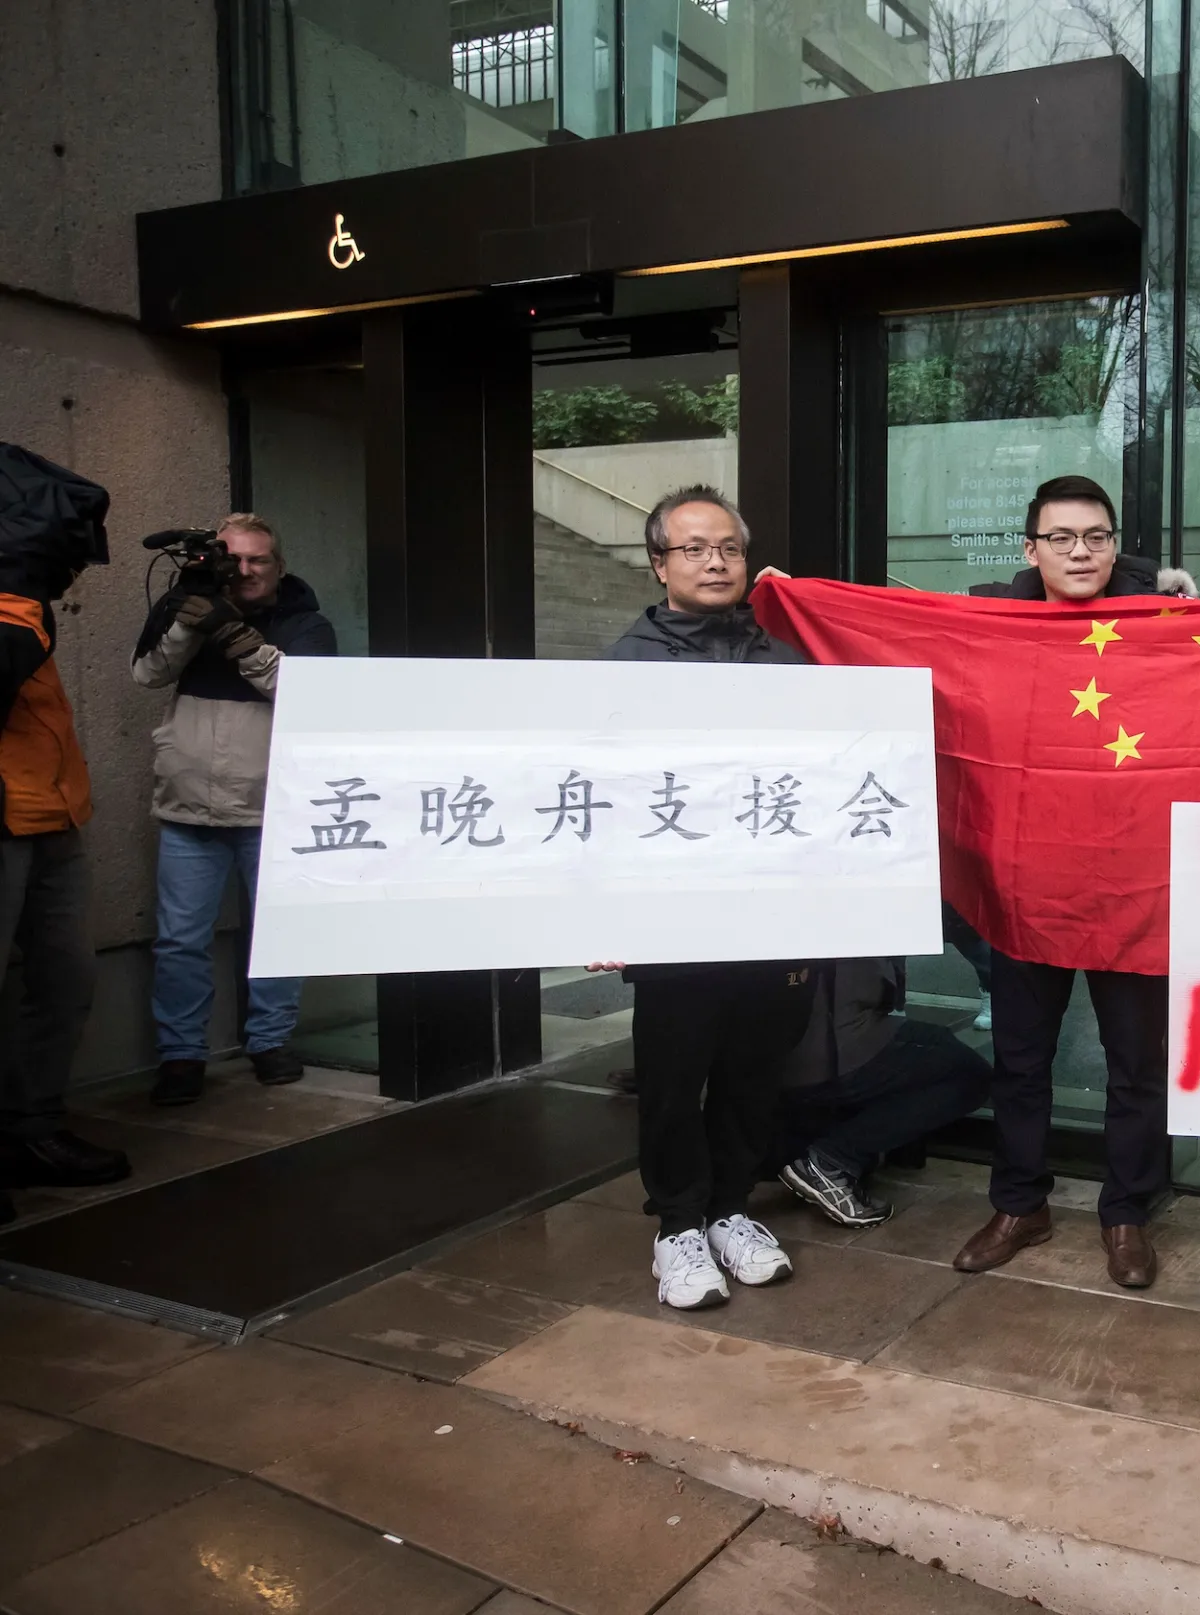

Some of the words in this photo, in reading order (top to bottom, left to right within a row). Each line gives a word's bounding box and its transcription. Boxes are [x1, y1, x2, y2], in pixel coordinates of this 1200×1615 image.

[960, 476, 983, 490] For
[946, 495, 992, 510] before
[995, 494, 1025, 508] 8:45
[947, 515, 993, 532] please
[997, 515, 1023, 527] use
[951, 532, 1000, 548] Smithe
[1003, 531, 1026, 546] Str
[966, 551, 1029, 566] Entrance
[290, 768, 912, 856] 孟晚舟支援会
